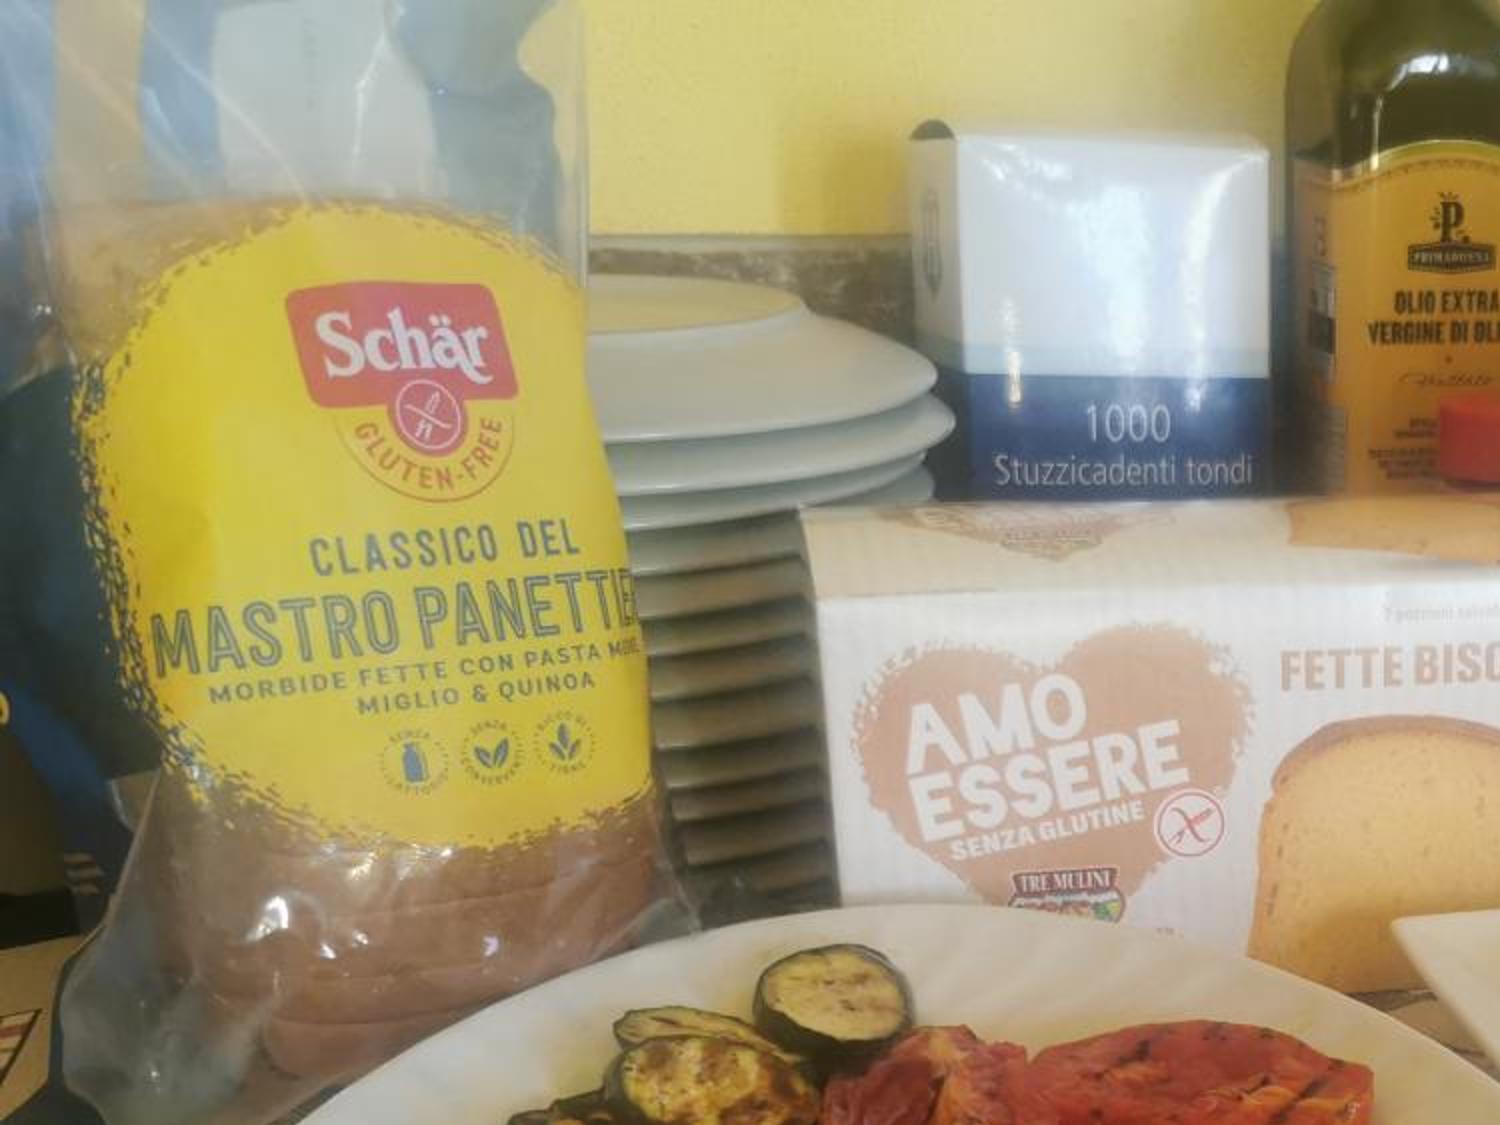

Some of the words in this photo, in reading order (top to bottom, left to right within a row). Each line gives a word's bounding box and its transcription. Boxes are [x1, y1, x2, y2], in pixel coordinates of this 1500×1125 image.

[1394, 291, 1436, 314] OLIO
[1441, 289, 1500, 313] EXTRA
[315, 305, 493, 385] Schär
[1369, 320, 1444, 344] VERGINE
[1451, 320, 1468, 343] DI
[1087, 403, 1170, 443] 1000
[354, 416, 502, 490] GLUTEN-FREE
[994, 454, 1177, 486] Stuzzicadenti
[1187, 454, 1254, 485] tondi
[309, 524, 497, 577] CLASSICO
[517, 518, 580, 557] DEL
[151, 591, 400, 678] MASTRO
[209, 671, 347, 704] MORBIDE
[359, 661, 447, 687] FETTE
[460, 652, 514, 676] CON
[524, 642, 601, 668] PASTA
[357, 687, 459, 715] MIGLIO
[472, 684, 488, 703] &
[499, 671, 595, 701] QUINOA
[1280, 646, 1404, 692] FETTE
[906, 673, 1087, 775] AMO
[909, 719, 1190, 842] ESSERE
[951, 824, 1036, 861] SENZA
[1039, 800, 1146, 842] GLUTINE
[1018, 875, 1050, 893] TRE
[1055, 869, 1114, 890] MULINI
